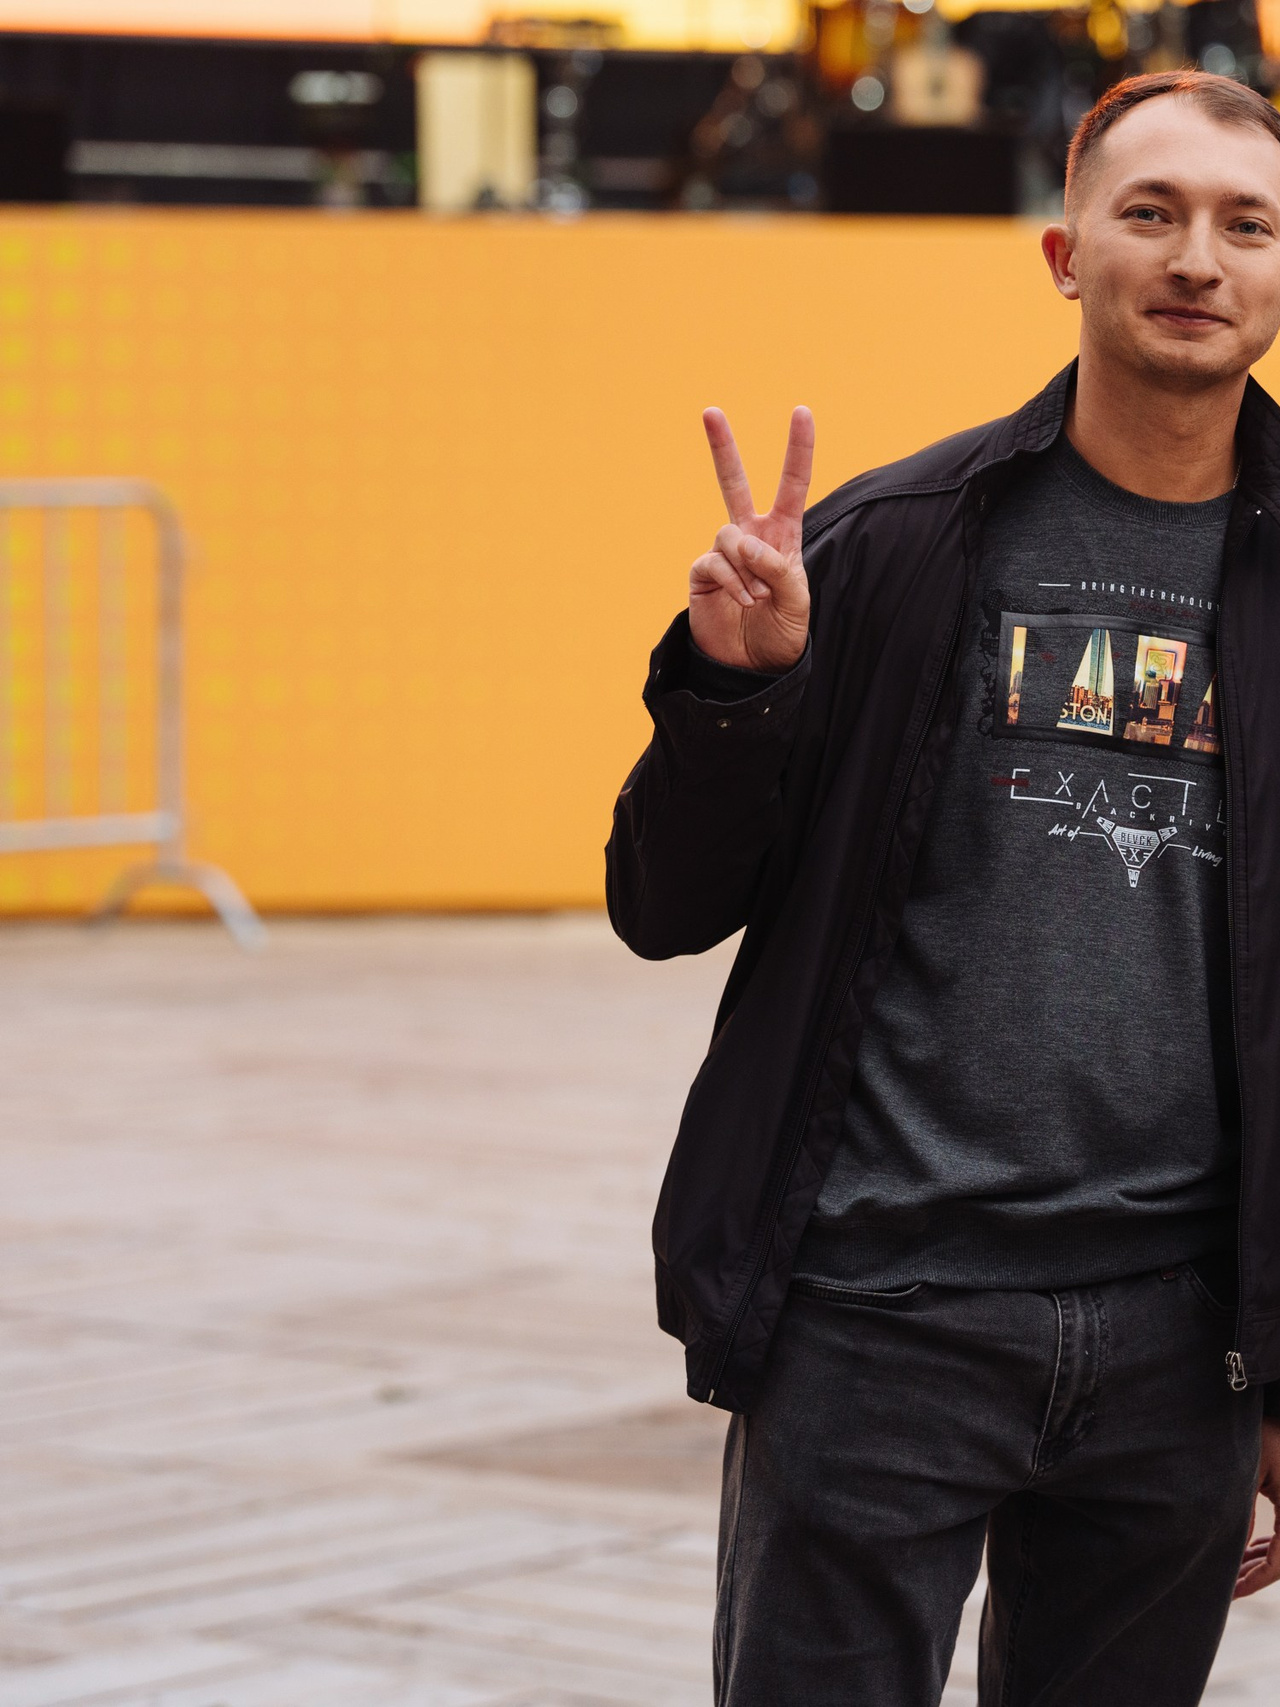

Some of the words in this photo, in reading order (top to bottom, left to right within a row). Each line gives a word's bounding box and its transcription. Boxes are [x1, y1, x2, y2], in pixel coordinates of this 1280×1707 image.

[1048, 824, 1067, 837] Art
[1067, 826, 1081, 841] of
[1128, 848, 1140, 862] X
[1192, 845, 1223, 867] Living
